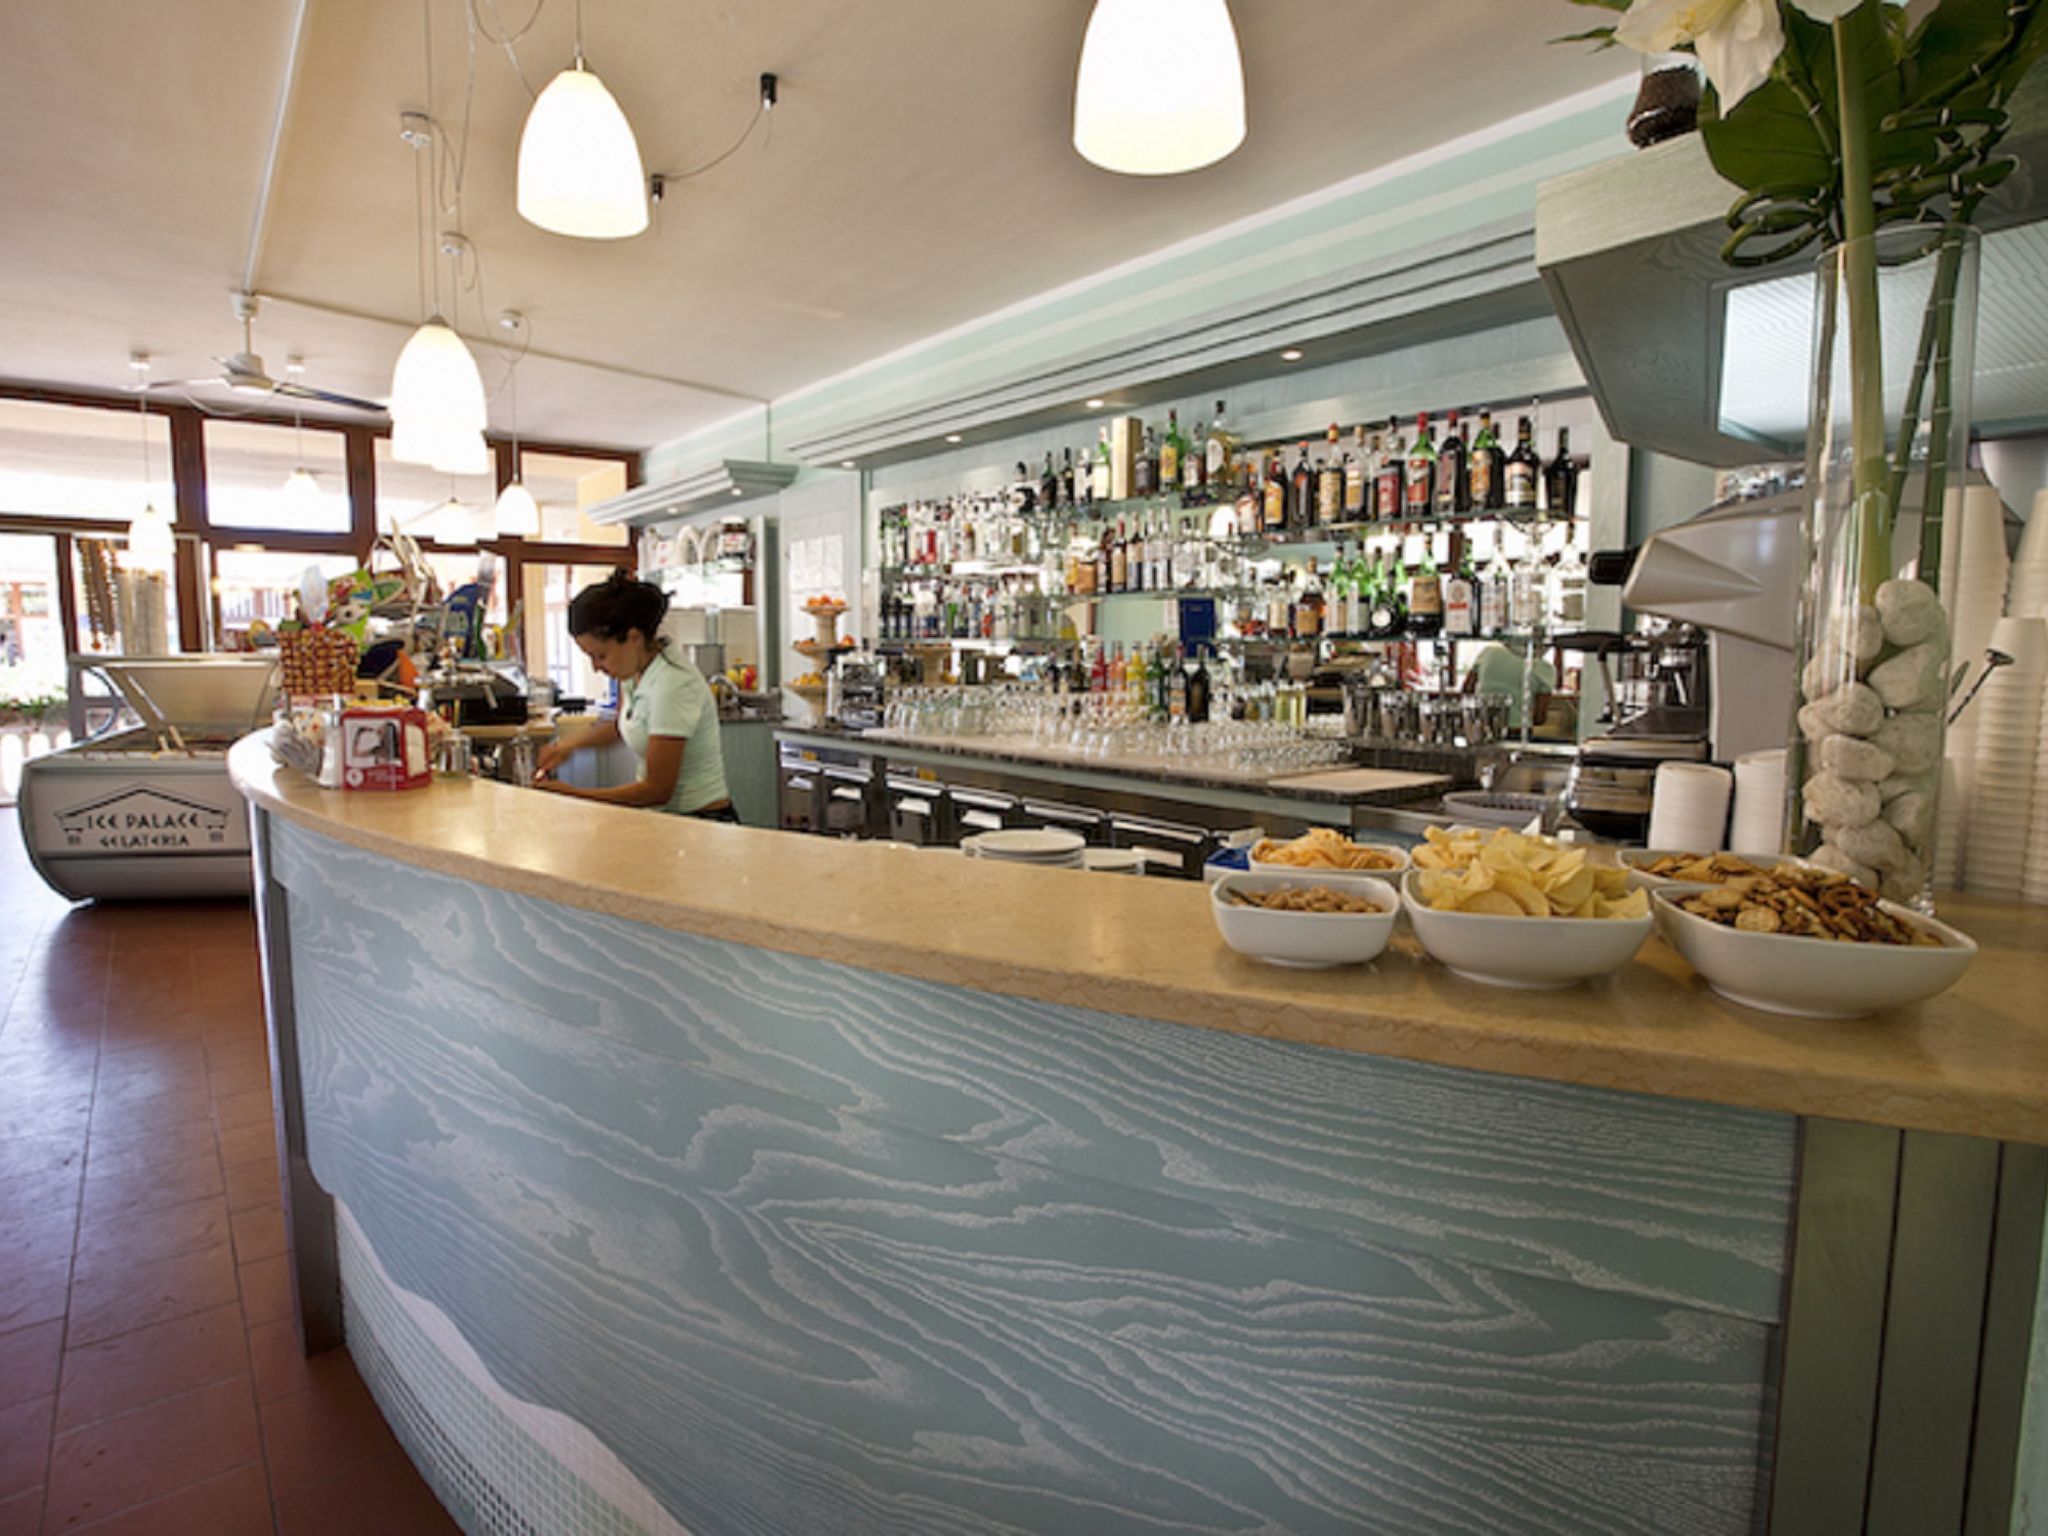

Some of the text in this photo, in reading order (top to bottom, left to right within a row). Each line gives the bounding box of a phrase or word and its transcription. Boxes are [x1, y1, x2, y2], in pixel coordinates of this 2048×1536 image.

[87, 812, 199, 830] ICE PALACE
[99, 833, 190, 848] GELATERIA
